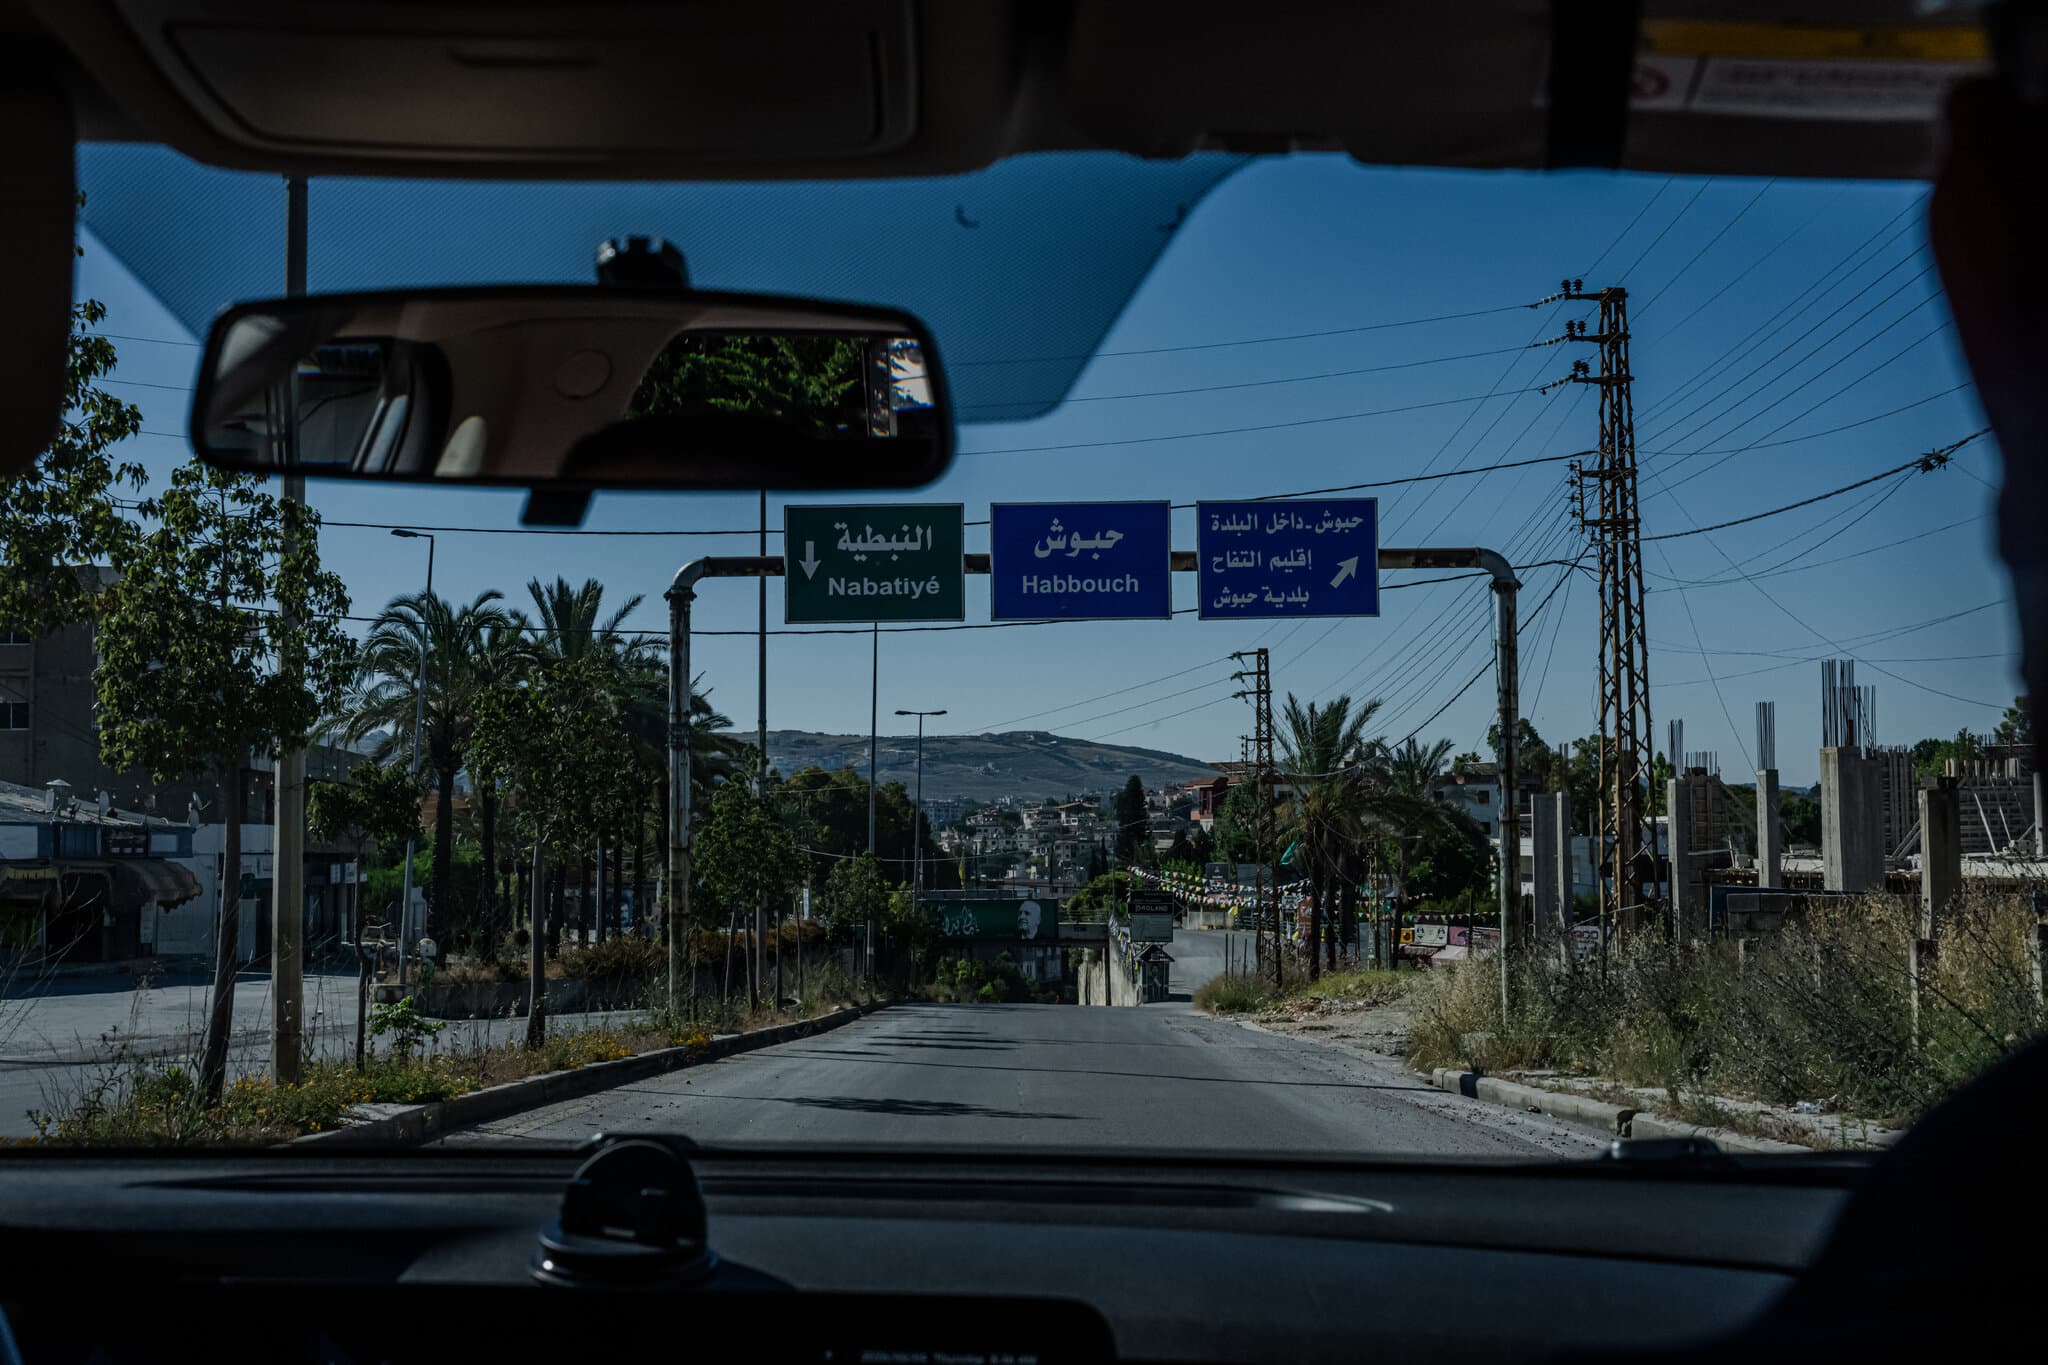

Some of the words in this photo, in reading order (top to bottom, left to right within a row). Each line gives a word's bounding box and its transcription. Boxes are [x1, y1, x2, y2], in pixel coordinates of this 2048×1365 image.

[1211, 513, 1258, 536] البلدة
[834, 522, 932, 562] النبطية
[1034, 517, 1125, 560] حبوش
[1211, 549, 1262, 573] التفاح
[1270, 548, 1312, 573] إقليم
[828, 575, 941, 600] Nabatiyé
[1022, 574, 1139, 594] Habbouch
[1213, 586, 1258, 609] حبوش
[1261, 585, 1310, 608] بلدية
